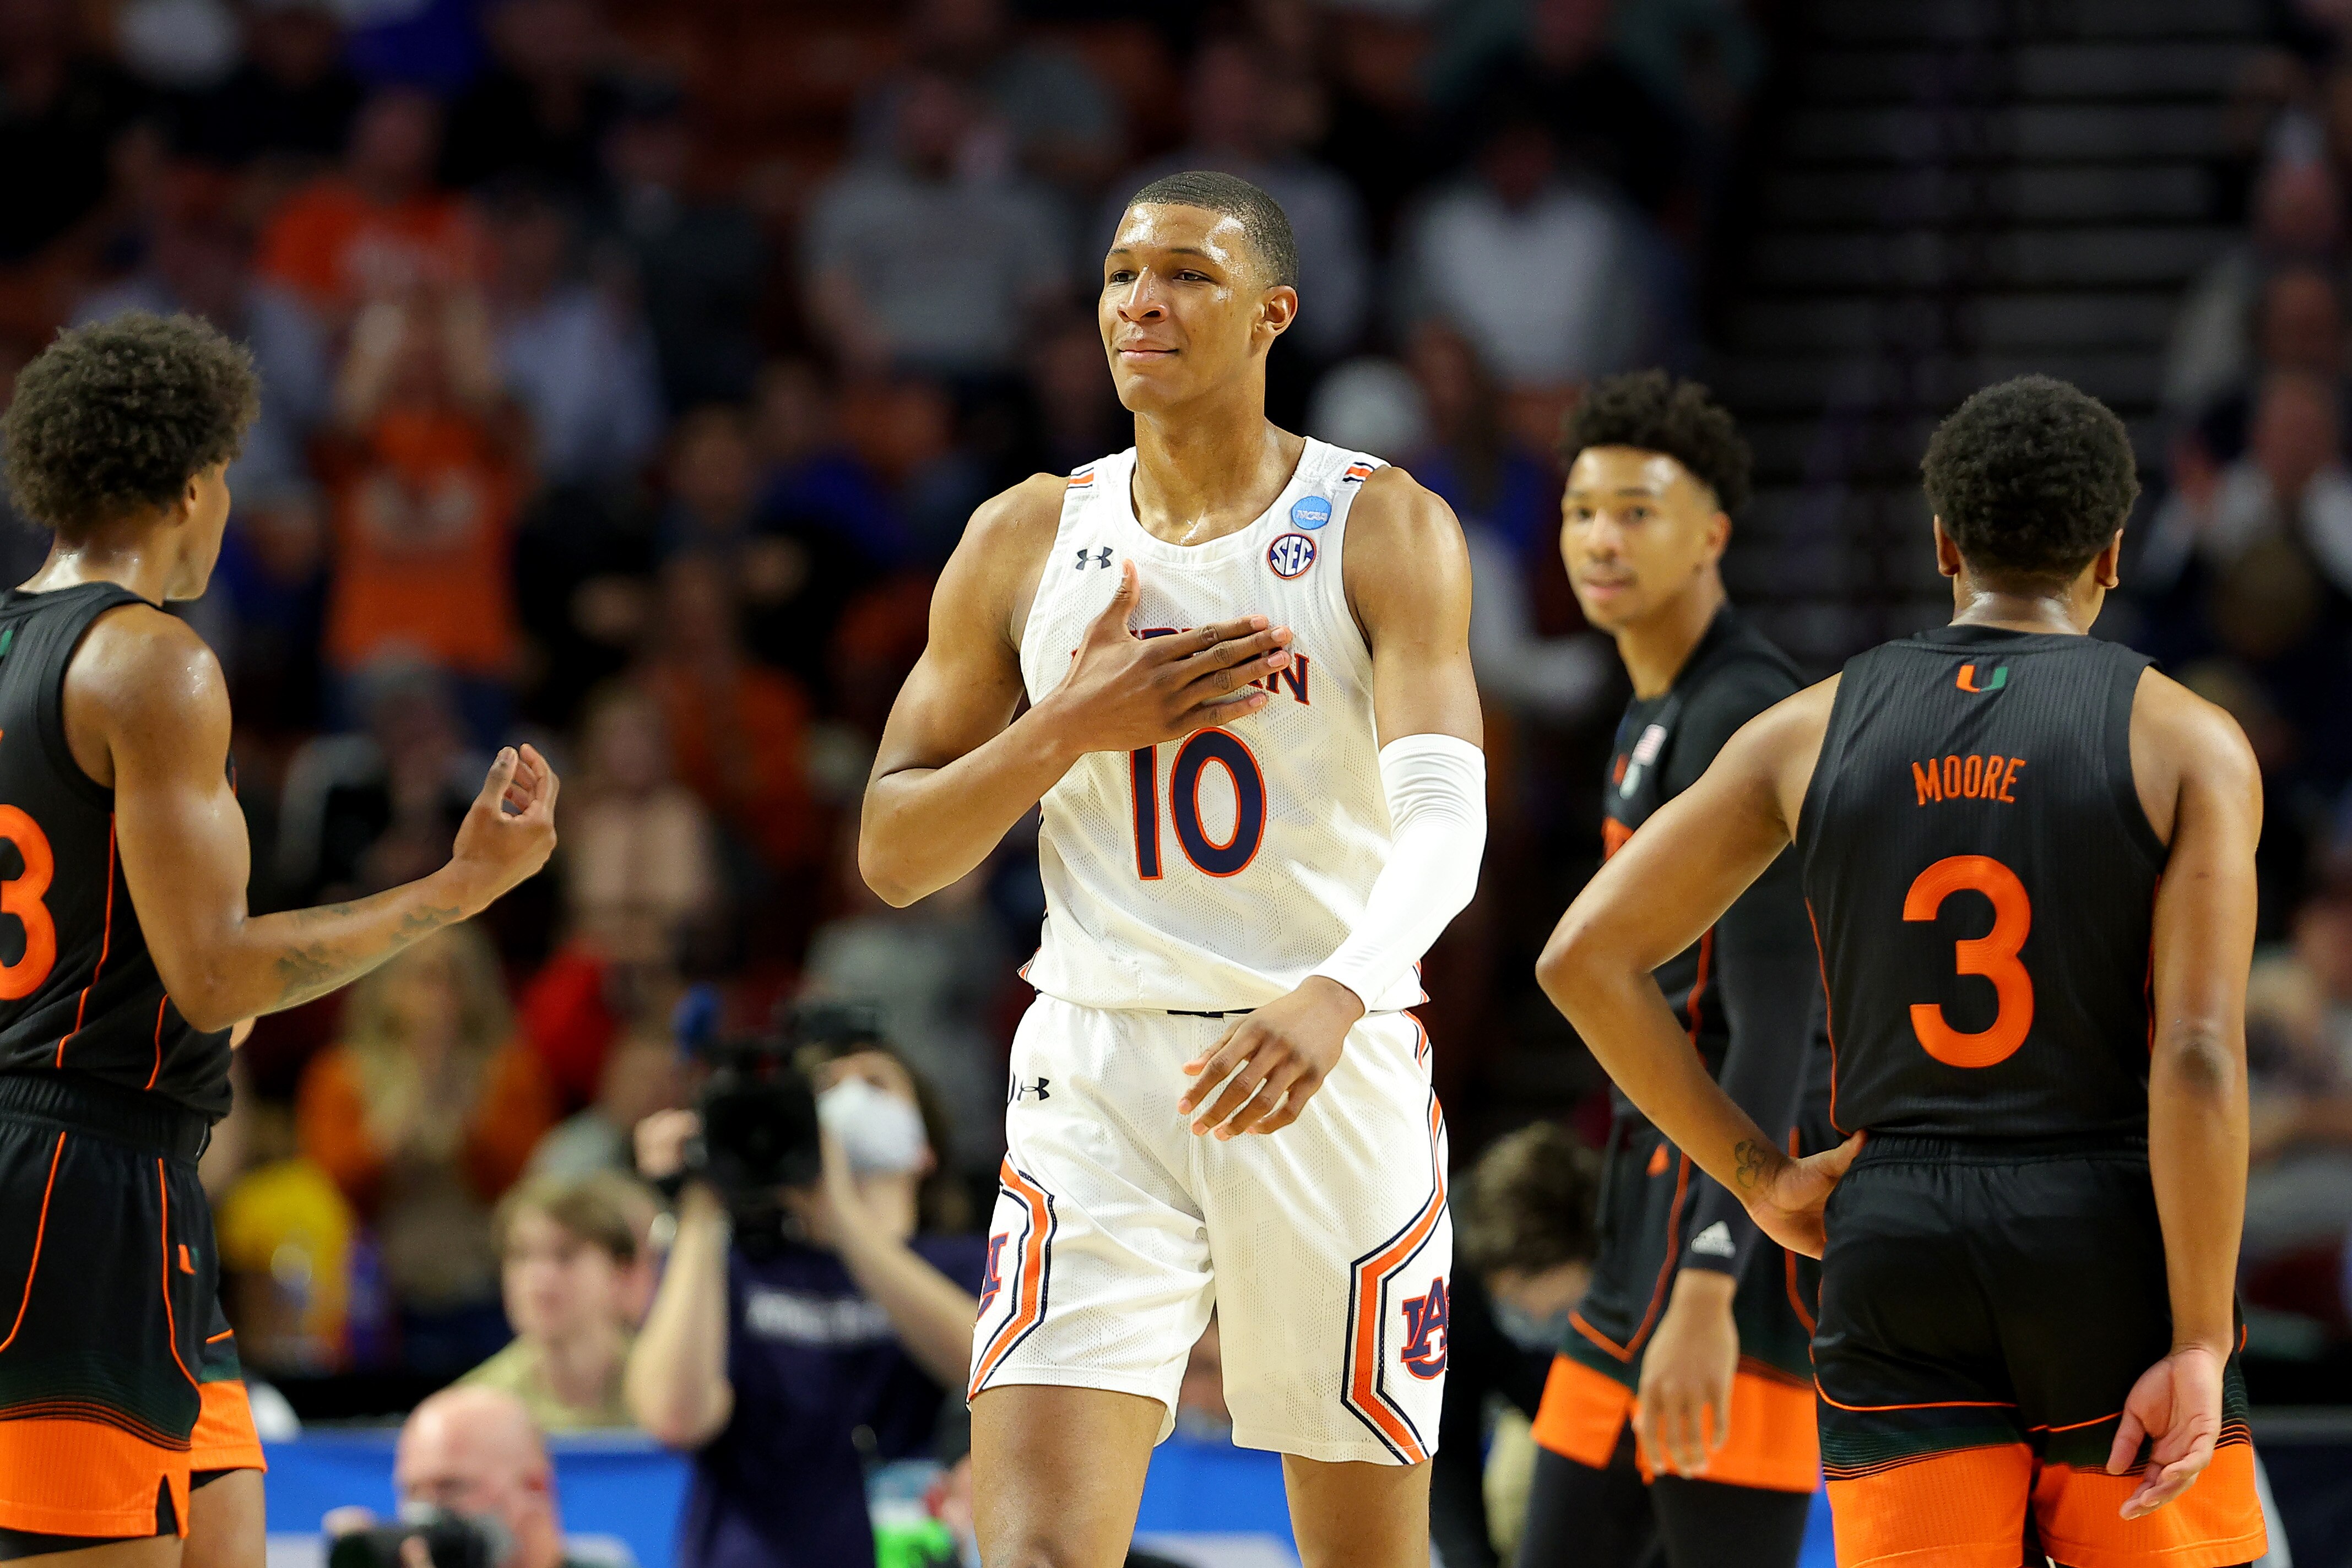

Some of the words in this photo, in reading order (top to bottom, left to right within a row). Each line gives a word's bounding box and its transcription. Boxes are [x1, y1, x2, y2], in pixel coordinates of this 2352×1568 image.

[1296, 509, 1329, 523] NCAA
[1271, 536, 1314, 575] SEC
[1130, 726, 1266, 881] 10
[1912, 755, 2026, 806] MOORE
[1903, 854, 2035, 1068] 3
